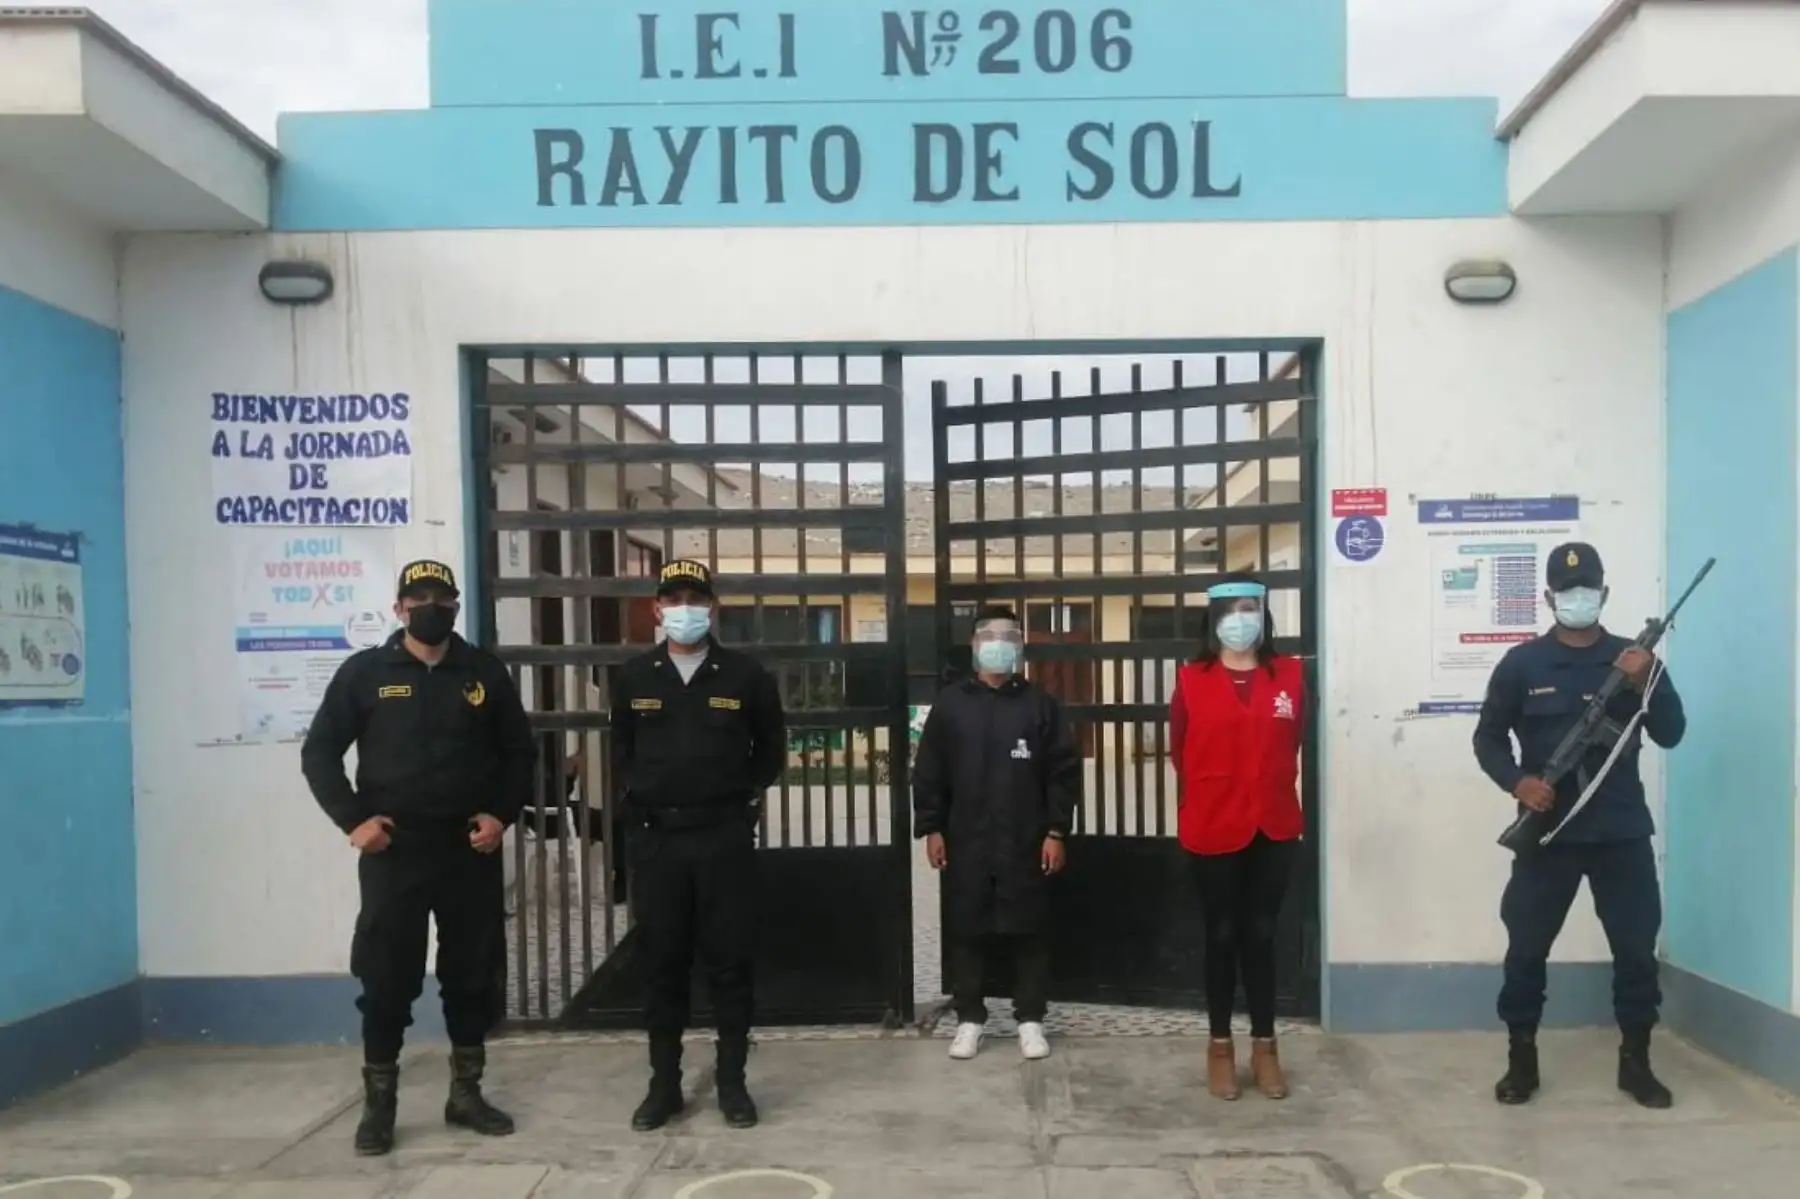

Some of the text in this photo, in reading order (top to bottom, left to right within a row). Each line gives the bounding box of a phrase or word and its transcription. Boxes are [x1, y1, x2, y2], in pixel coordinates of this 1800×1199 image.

[532, 119, 1242, 207] RAYITO DE SOL
[211, 392, 410, 424] BIENVENIDOS
[211, 428, 411, 460] A LA JORNADA
[289, 463, 329, 491] DE
[216, 496, 408, 525] CAPACITACION
[264, 560, 364, 580] VOTAMOS
[404, 563, 453, 585] POLICIA
[660, 561, 706, 584] POLICIA
